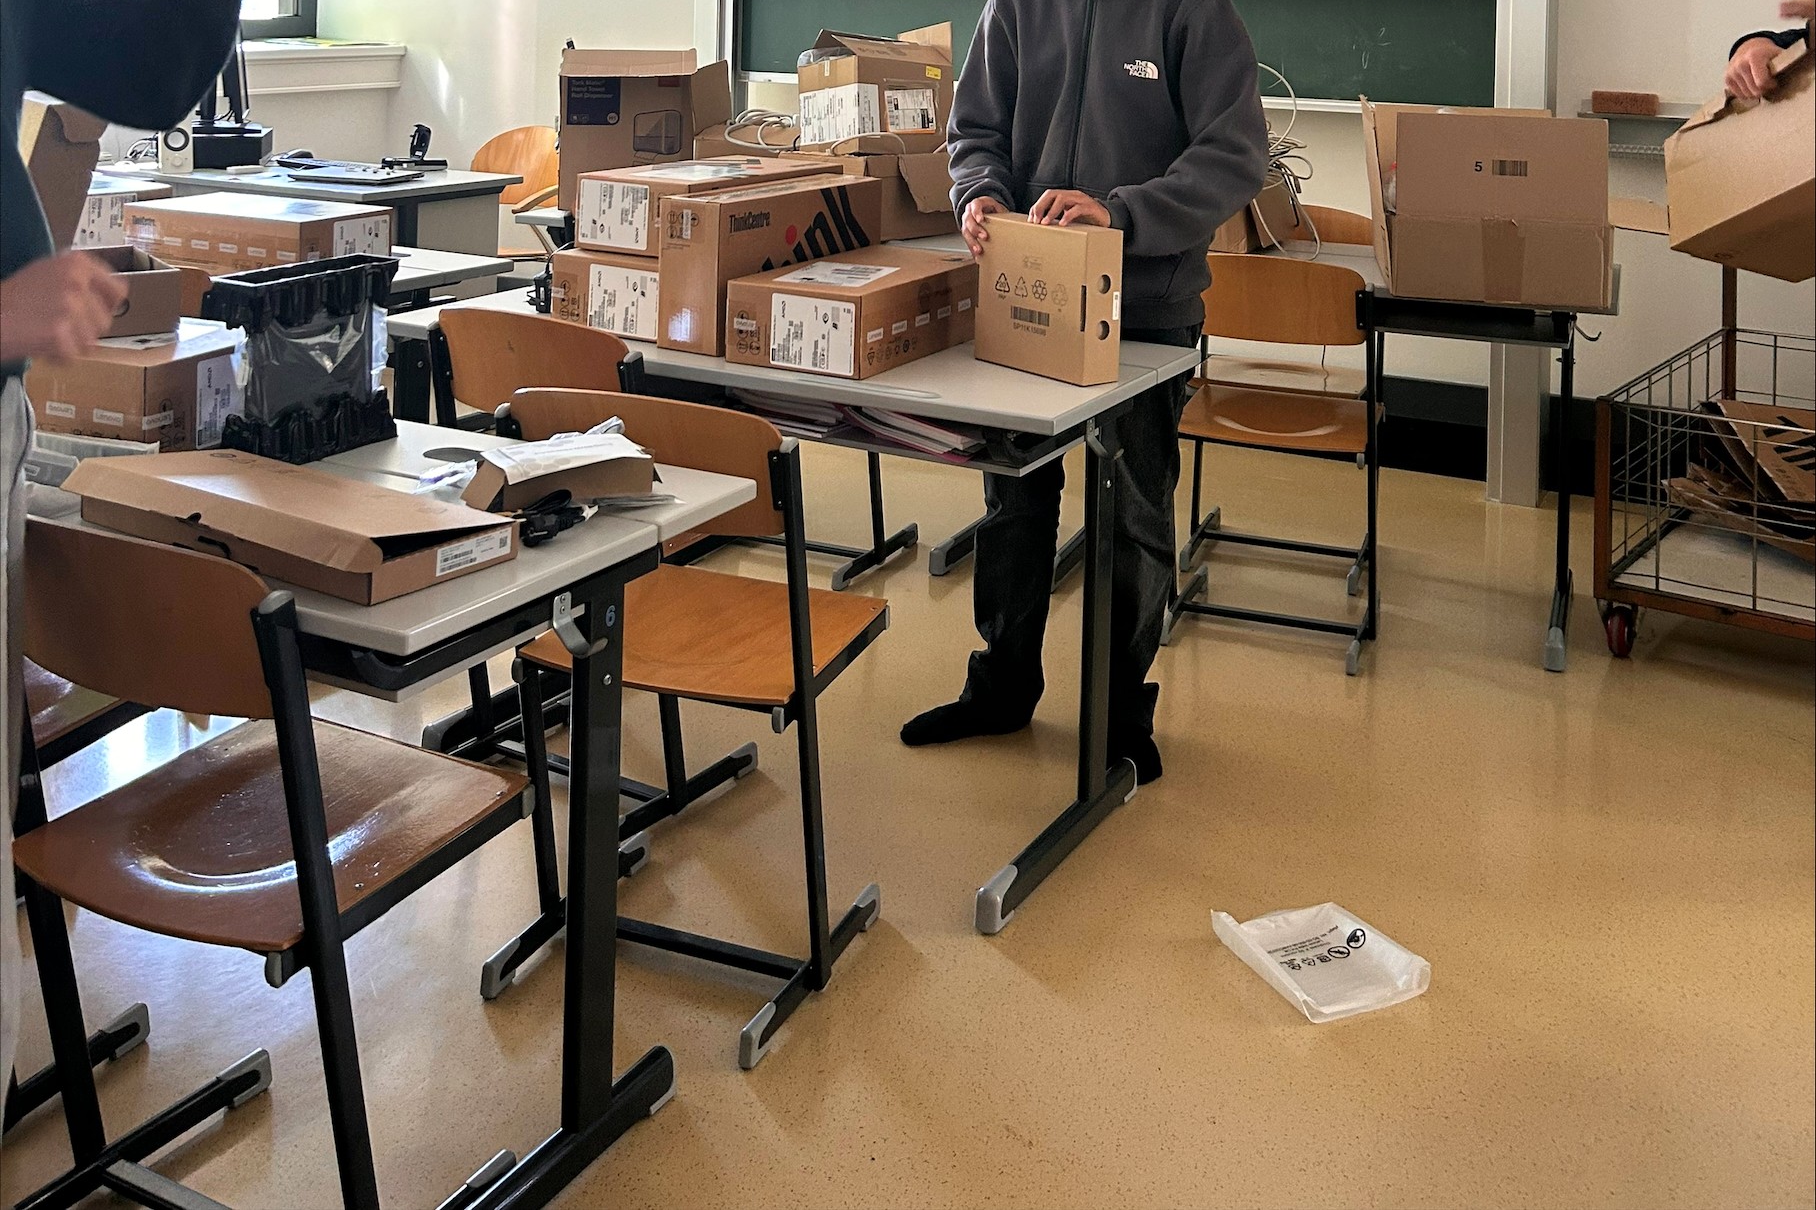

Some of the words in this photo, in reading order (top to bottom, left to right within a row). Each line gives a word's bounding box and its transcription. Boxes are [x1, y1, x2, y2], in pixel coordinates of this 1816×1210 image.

[1123, 63, 1147, 72] NORTH
[1474, 161, 1483, 172] 5
[729, 210, 771, 234] ThinkCentre
[48, 404, 74, 415] Lenovo
[95, 412, 121, 423] Lenovo
[146, 414, 172, 426] Lenovo
[605, 604, 616, 627] 6
